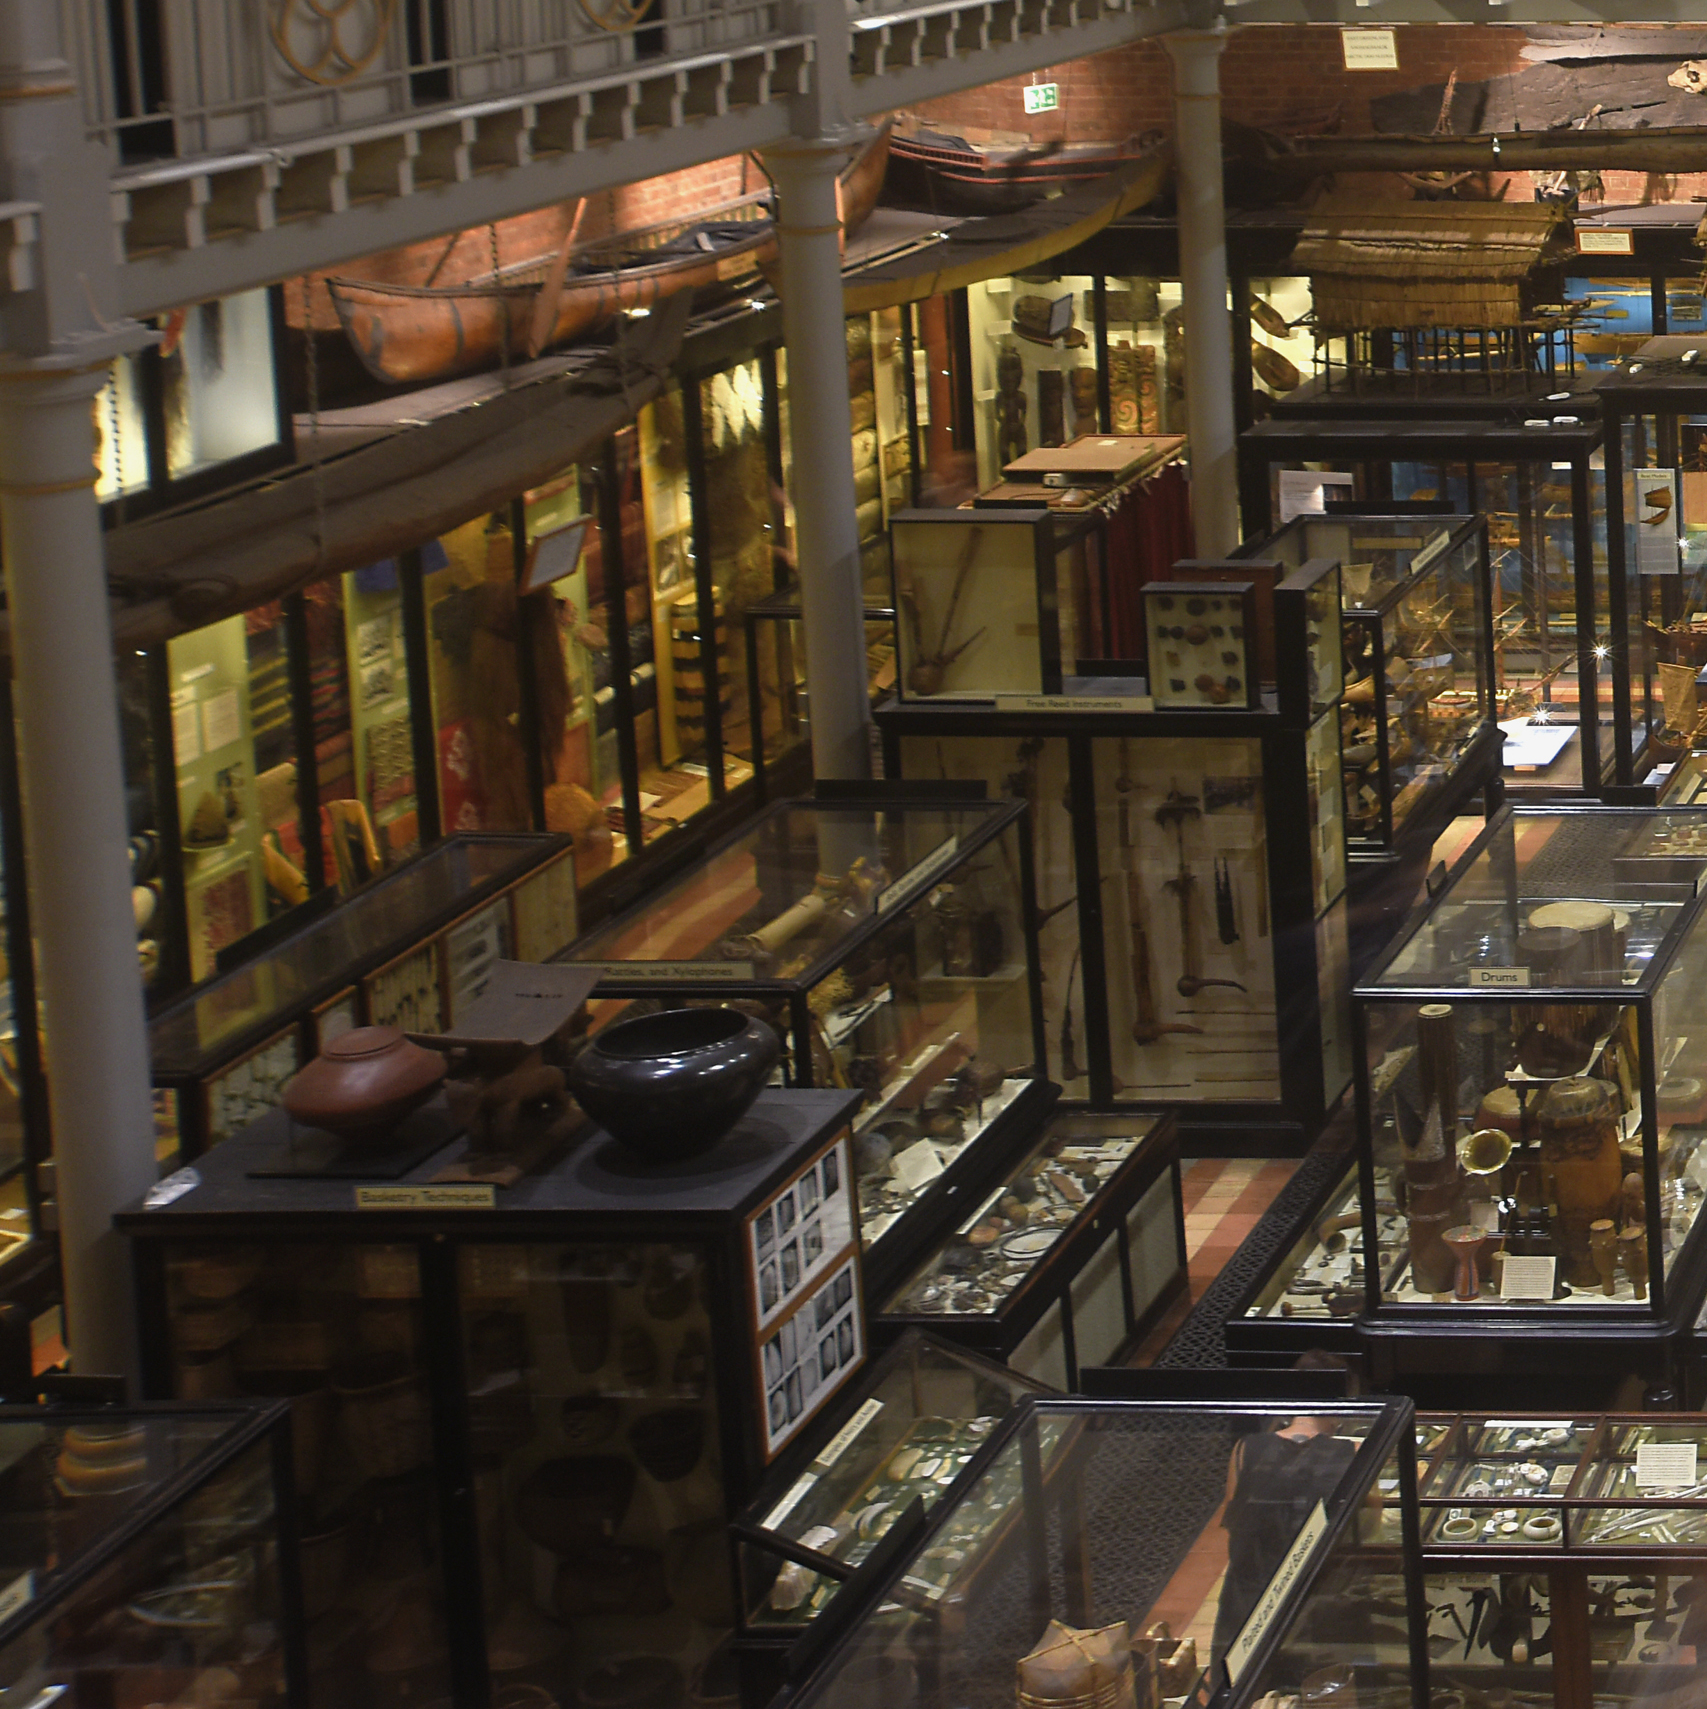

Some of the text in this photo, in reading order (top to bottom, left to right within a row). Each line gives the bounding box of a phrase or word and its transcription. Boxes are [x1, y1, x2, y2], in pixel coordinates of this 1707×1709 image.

[1073, 700, 1122, 708] Instruments
[649, 967, 668, 976] and
[673, 967, 733, 978] Xylophones
[1481, 972, 1518, 982] Drums
[361, 1190, 489, 1204] Basketry Techniques
